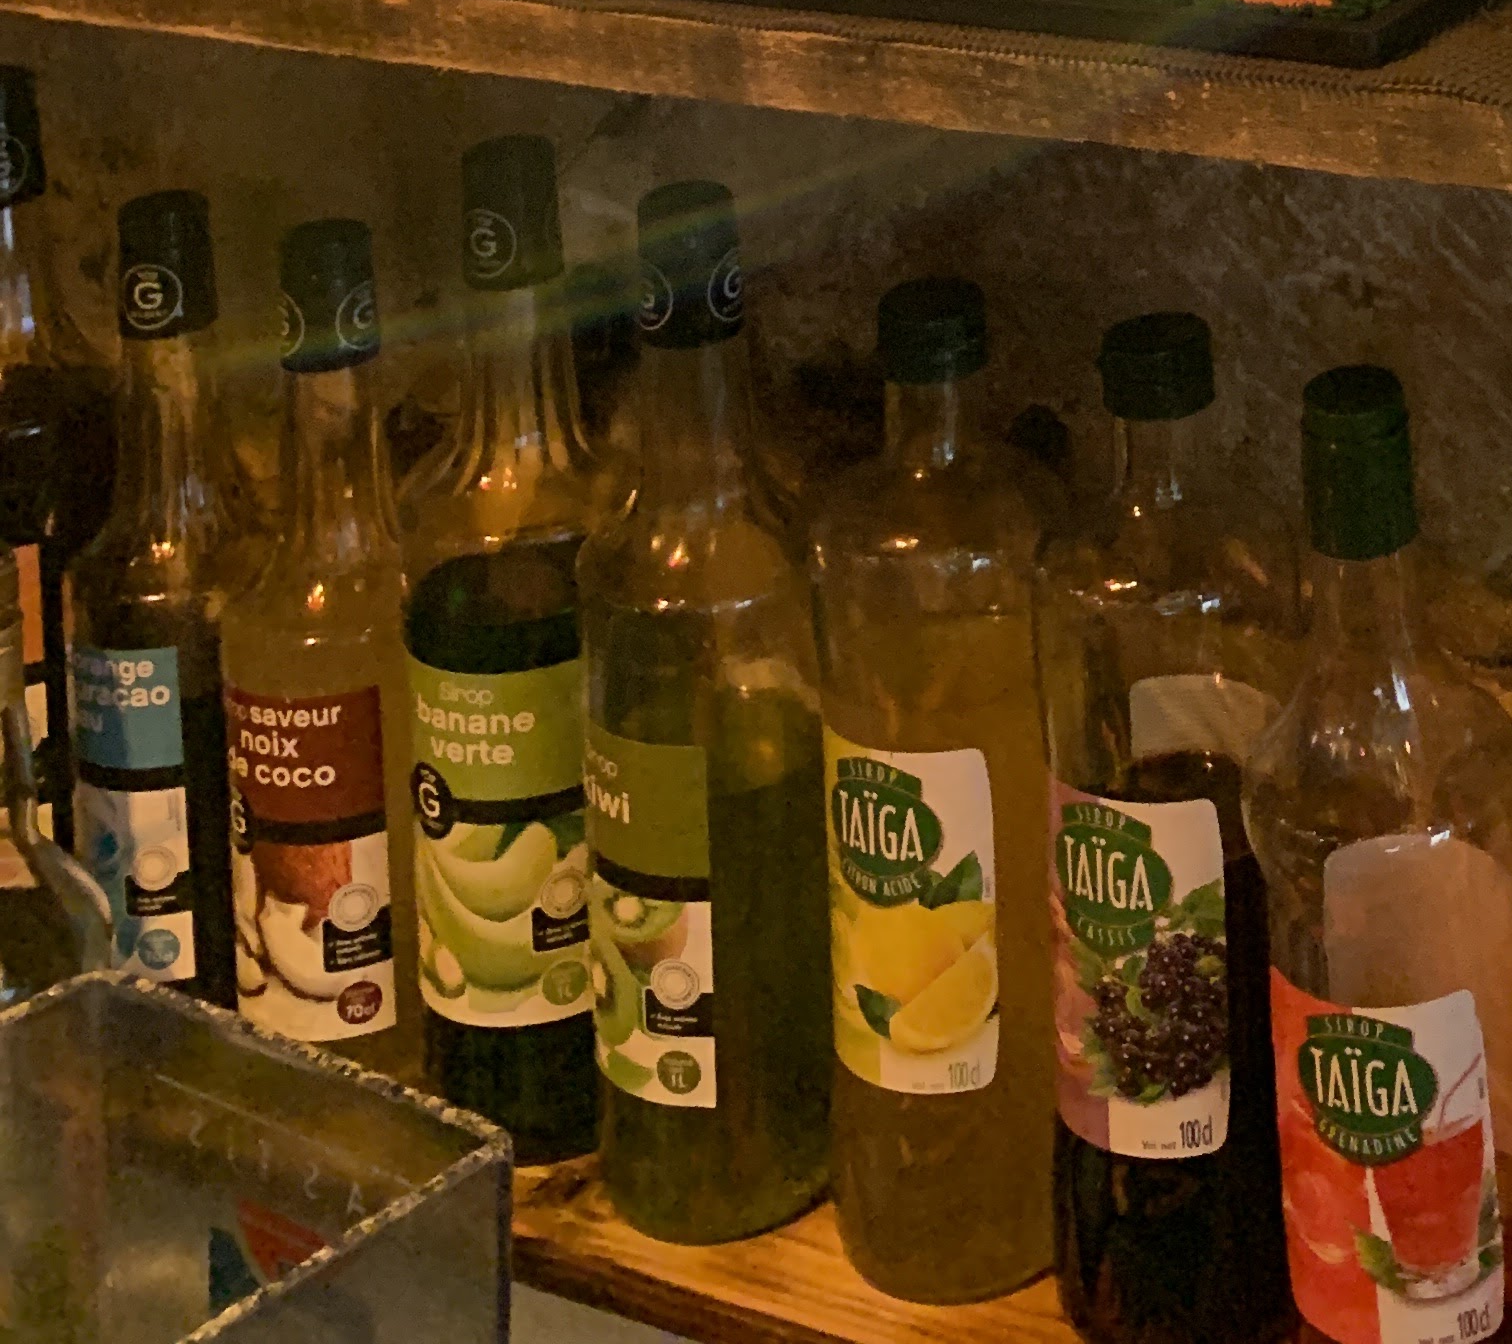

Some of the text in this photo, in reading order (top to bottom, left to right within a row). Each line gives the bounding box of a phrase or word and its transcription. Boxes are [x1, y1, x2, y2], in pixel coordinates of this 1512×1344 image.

[250, 702, 343, 729] saveur
[416, 693, 536, 737] banane
[240, 727, 301, 759] noix
[430, 736, 516, 766] verte
[254, 764, 336, 789] coco
[848, 761, 899, 785] SIROP
[838, 789, 924, 862] TAÏGA
[1074, 804, 1127, 830] SIROP
[1063, 834, 1154, 912] TAÏGA
[1324, 1015, 1385, 1039] SIROP
[1309, 1046, 1419, 1117] TAÏGA
[1318, 1116, 1420, 1157] GRENADINE
